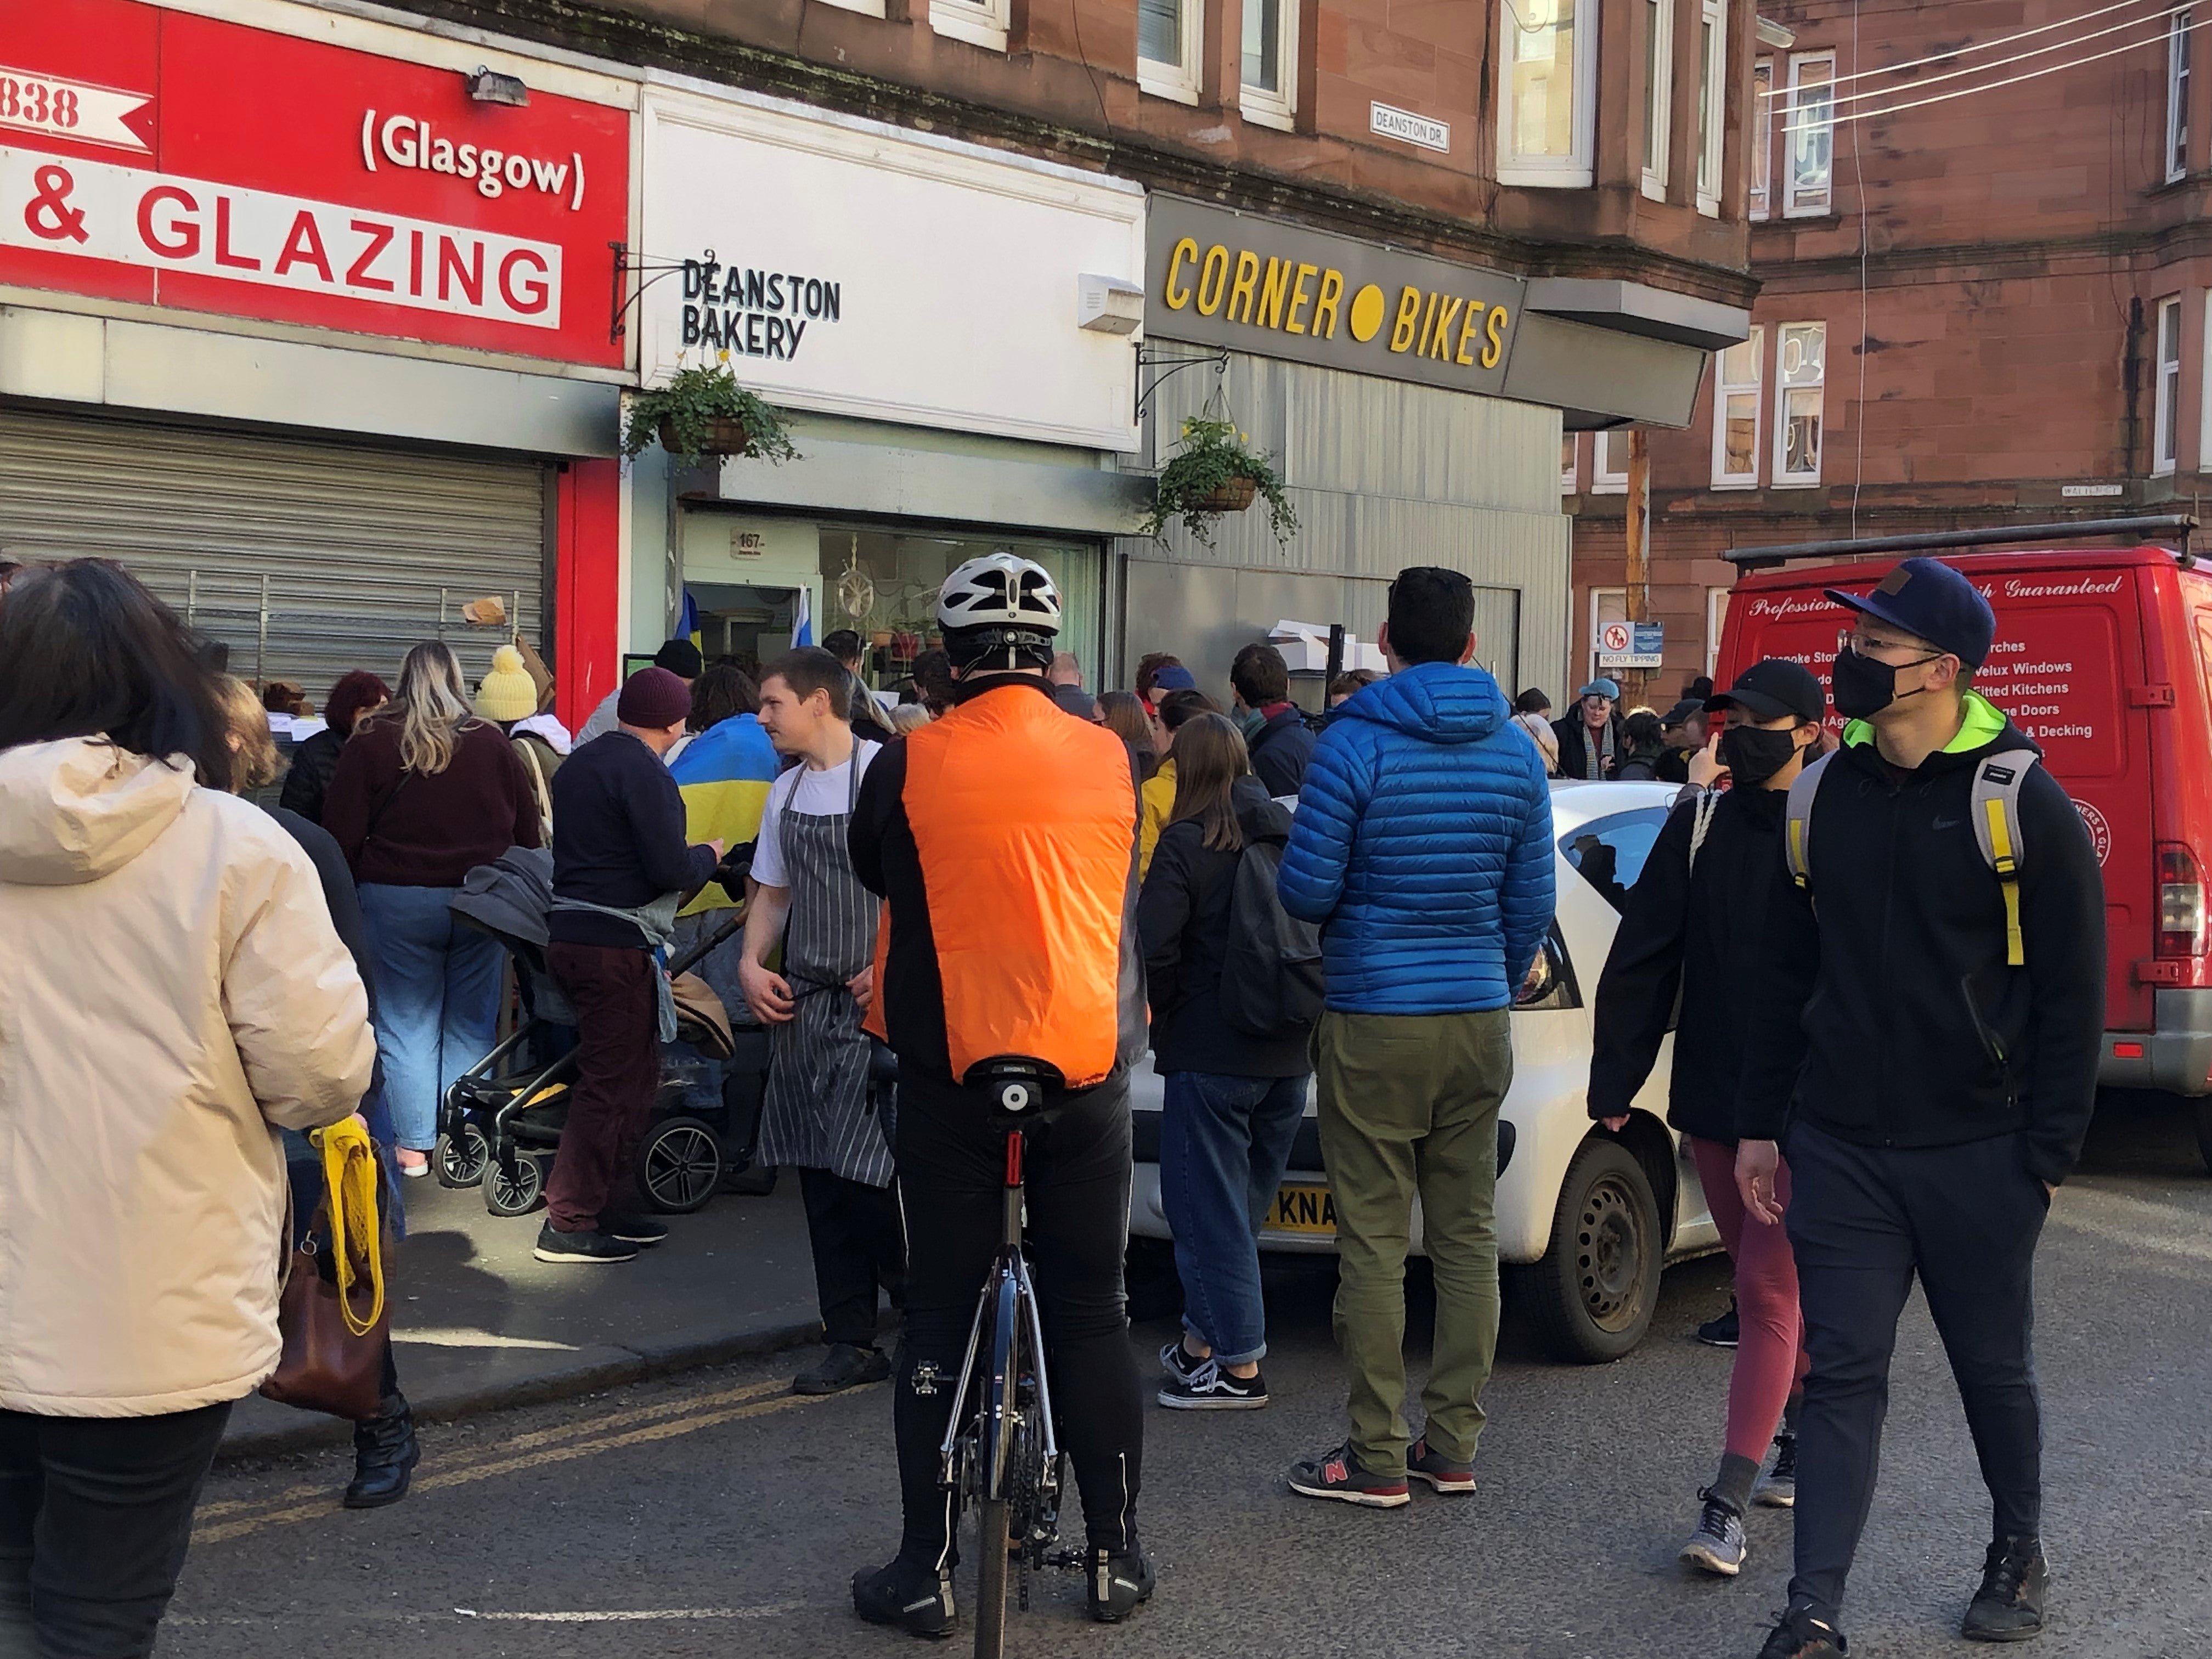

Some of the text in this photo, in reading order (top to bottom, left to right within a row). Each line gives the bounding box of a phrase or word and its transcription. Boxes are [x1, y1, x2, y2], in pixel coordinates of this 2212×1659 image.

[1376, 111, 1444, 144] DEANSTON DR.
[362, 109, 585, 211] (Glasgow)
[24, 165, 550, 314] & GLAZING
[684, 258, 840, 323] DEANSTON
[1165, 237, 1508, 369] CORNER BIKES
[684, 304, 806, 361] BAKERY
[740, 533, 760, 548] 167
[1748, 597, 1846, 621] Profession
[2005, 576, 2123, 597] Guaranteed
[2012, 662, 2072, 675] Windows
[2012, 682, 2069, 697] Kitchens
[2021, 704, 2059, 716] Doors
[2026, 725, 2092, 738] & Decking
[1278, 1191, 1337, 1225] KNA
